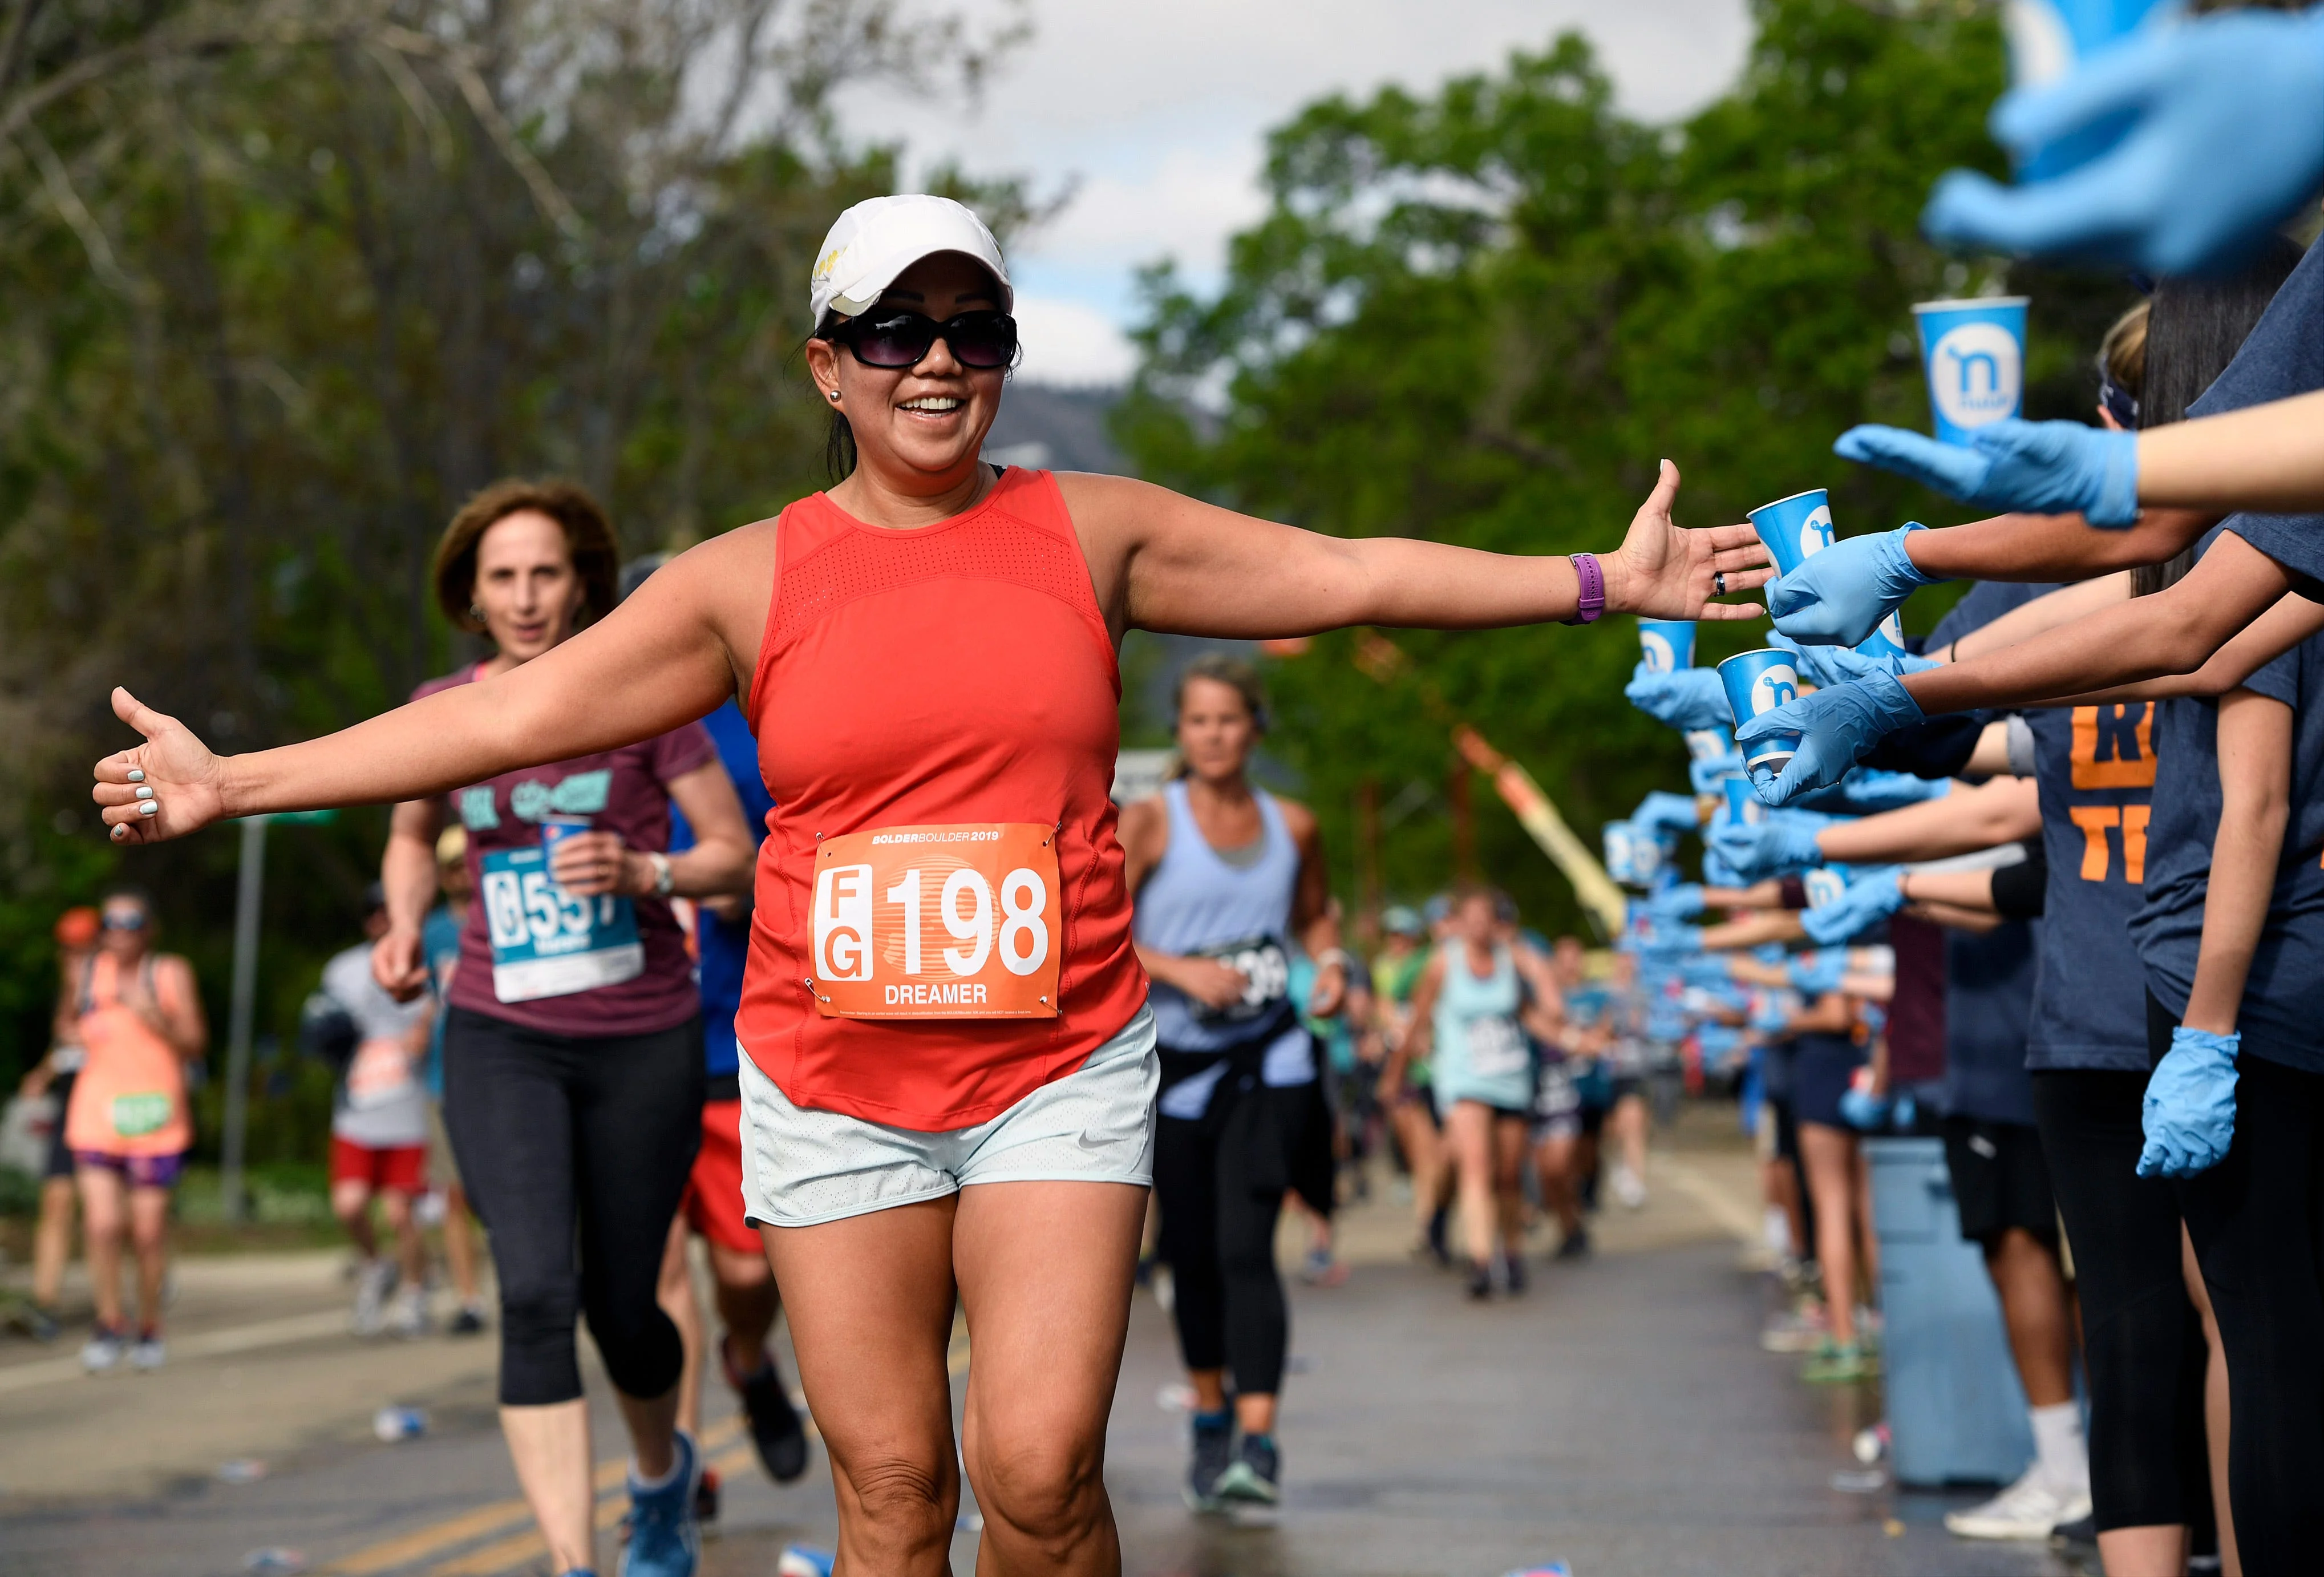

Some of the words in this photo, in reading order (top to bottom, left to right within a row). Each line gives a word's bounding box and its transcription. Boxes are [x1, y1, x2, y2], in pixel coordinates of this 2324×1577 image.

[1947, 346, 1998, 393] n
[1763, 676, 1796, 708] n
[872, 832, 969, 844] BOLDERBOULDER
[970, 831, 999, 841] 2019
[830, 870, 860, 919] F
[887, 867, 1048, 976] 198
[824, 925, 862, 978] G
[885, 984, 987, 1005] DREAMER
